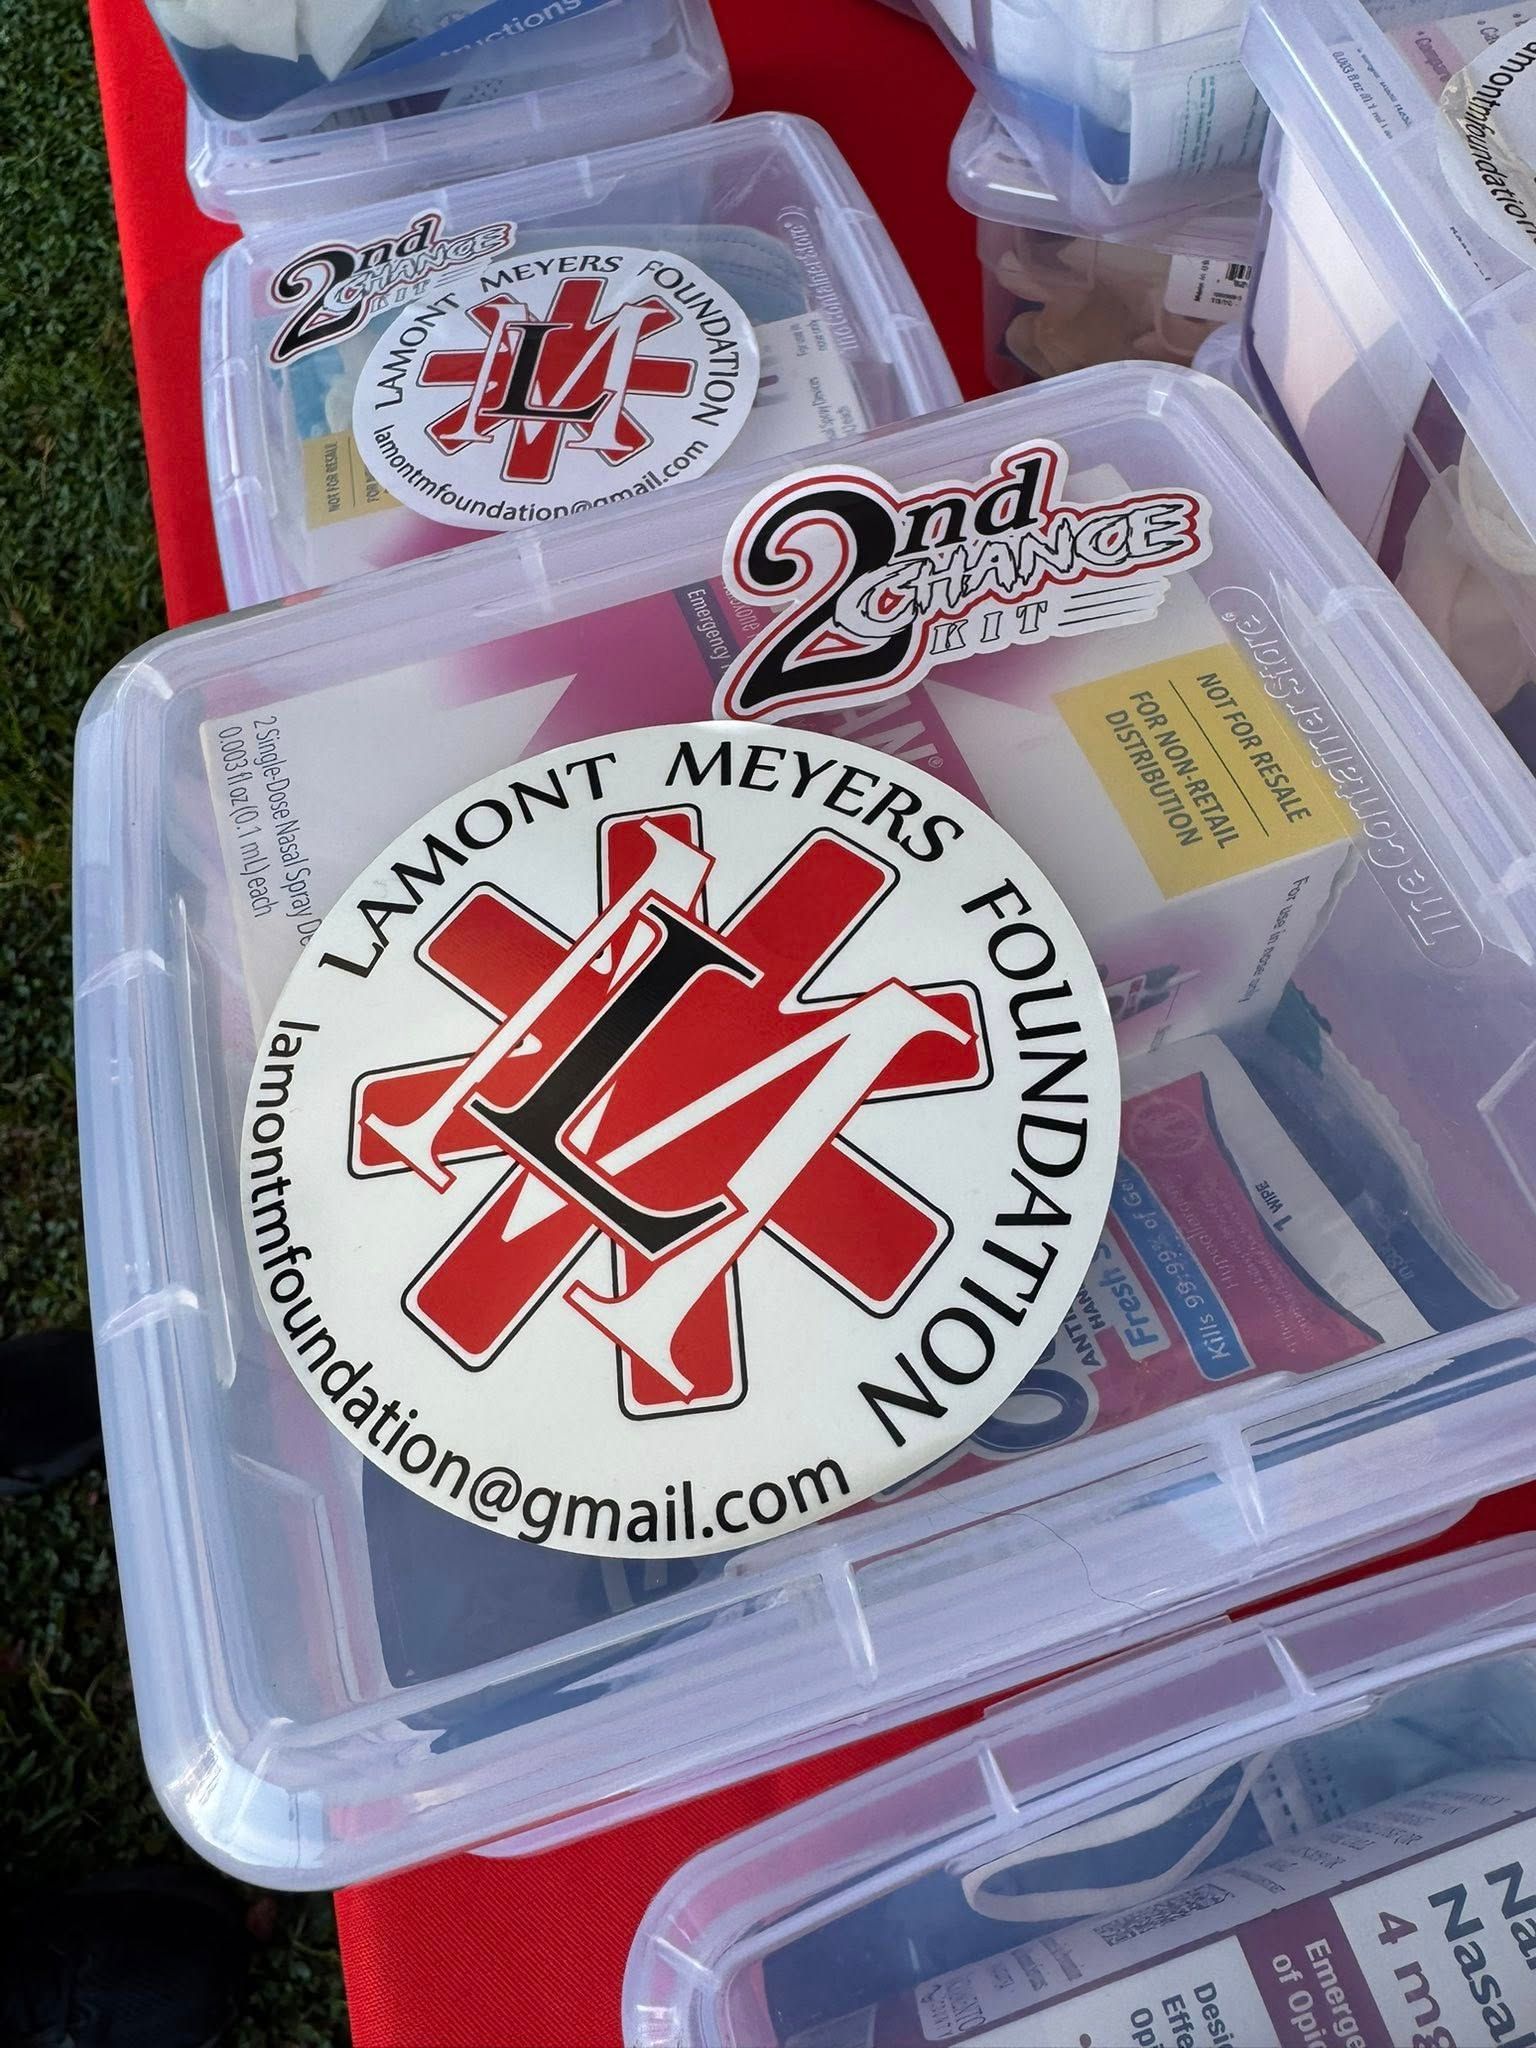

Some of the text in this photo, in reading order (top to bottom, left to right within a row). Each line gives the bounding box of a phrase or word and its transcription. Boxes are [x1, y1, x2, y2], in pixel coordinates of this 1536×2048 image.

[375, 291, 461, 411] LAMONT
[479, 254, 624, 293] MEYERS
[636, 259, 740, 428] FOUNDATION
[747, 456, 1042, 709] 2nd
[833, 504, 1194, 637] CHANCE
[686, 588, 732, 661] Emergency
[930, 600, 1048, 656] KIT
[218, 725, 249, 772] 0.003
[253, 715, 278, 729] 2
[1196, 672, 1313, 825] NOT FOR RESALE
[228, 786, 249, 807] oz
[253, 728, 291, 820] Single-Dose
[1104, 708, 1203, 848] DISTRIBUTION
[1129, 689, 1242, 850] FOR NON-RETAIL
[228, 805, 262, 839] (0.1
[275, 819, 310, 867] Nasal
[239, 840, 272, 876] mL)
[246, 876, 280, 918] each
[280, 867, 313, 918] Spray
[1286, 875, 1310, 902] For
[317, 752, 617, 979] LAMONT
[665, 740, 965, 862] MEYERS
[857, 877, 1090, 1448] FOUNDATION
[1132, 1211, 1159, 1230] of
[1254, 1179, 1294, 1233] 1 WIPE
[249, 1019, 852, 1545] lamontmfoundation@gmail.com
[1100, 1266, 1160, 1348] Fresh
[1200, 1312, 1232, 1361] Kills
[1377, 1911, 1419, 1946] 4
[1271, 1952, 1301, 1986] of
[1427, 1882, 1536, 2048] Nasal
